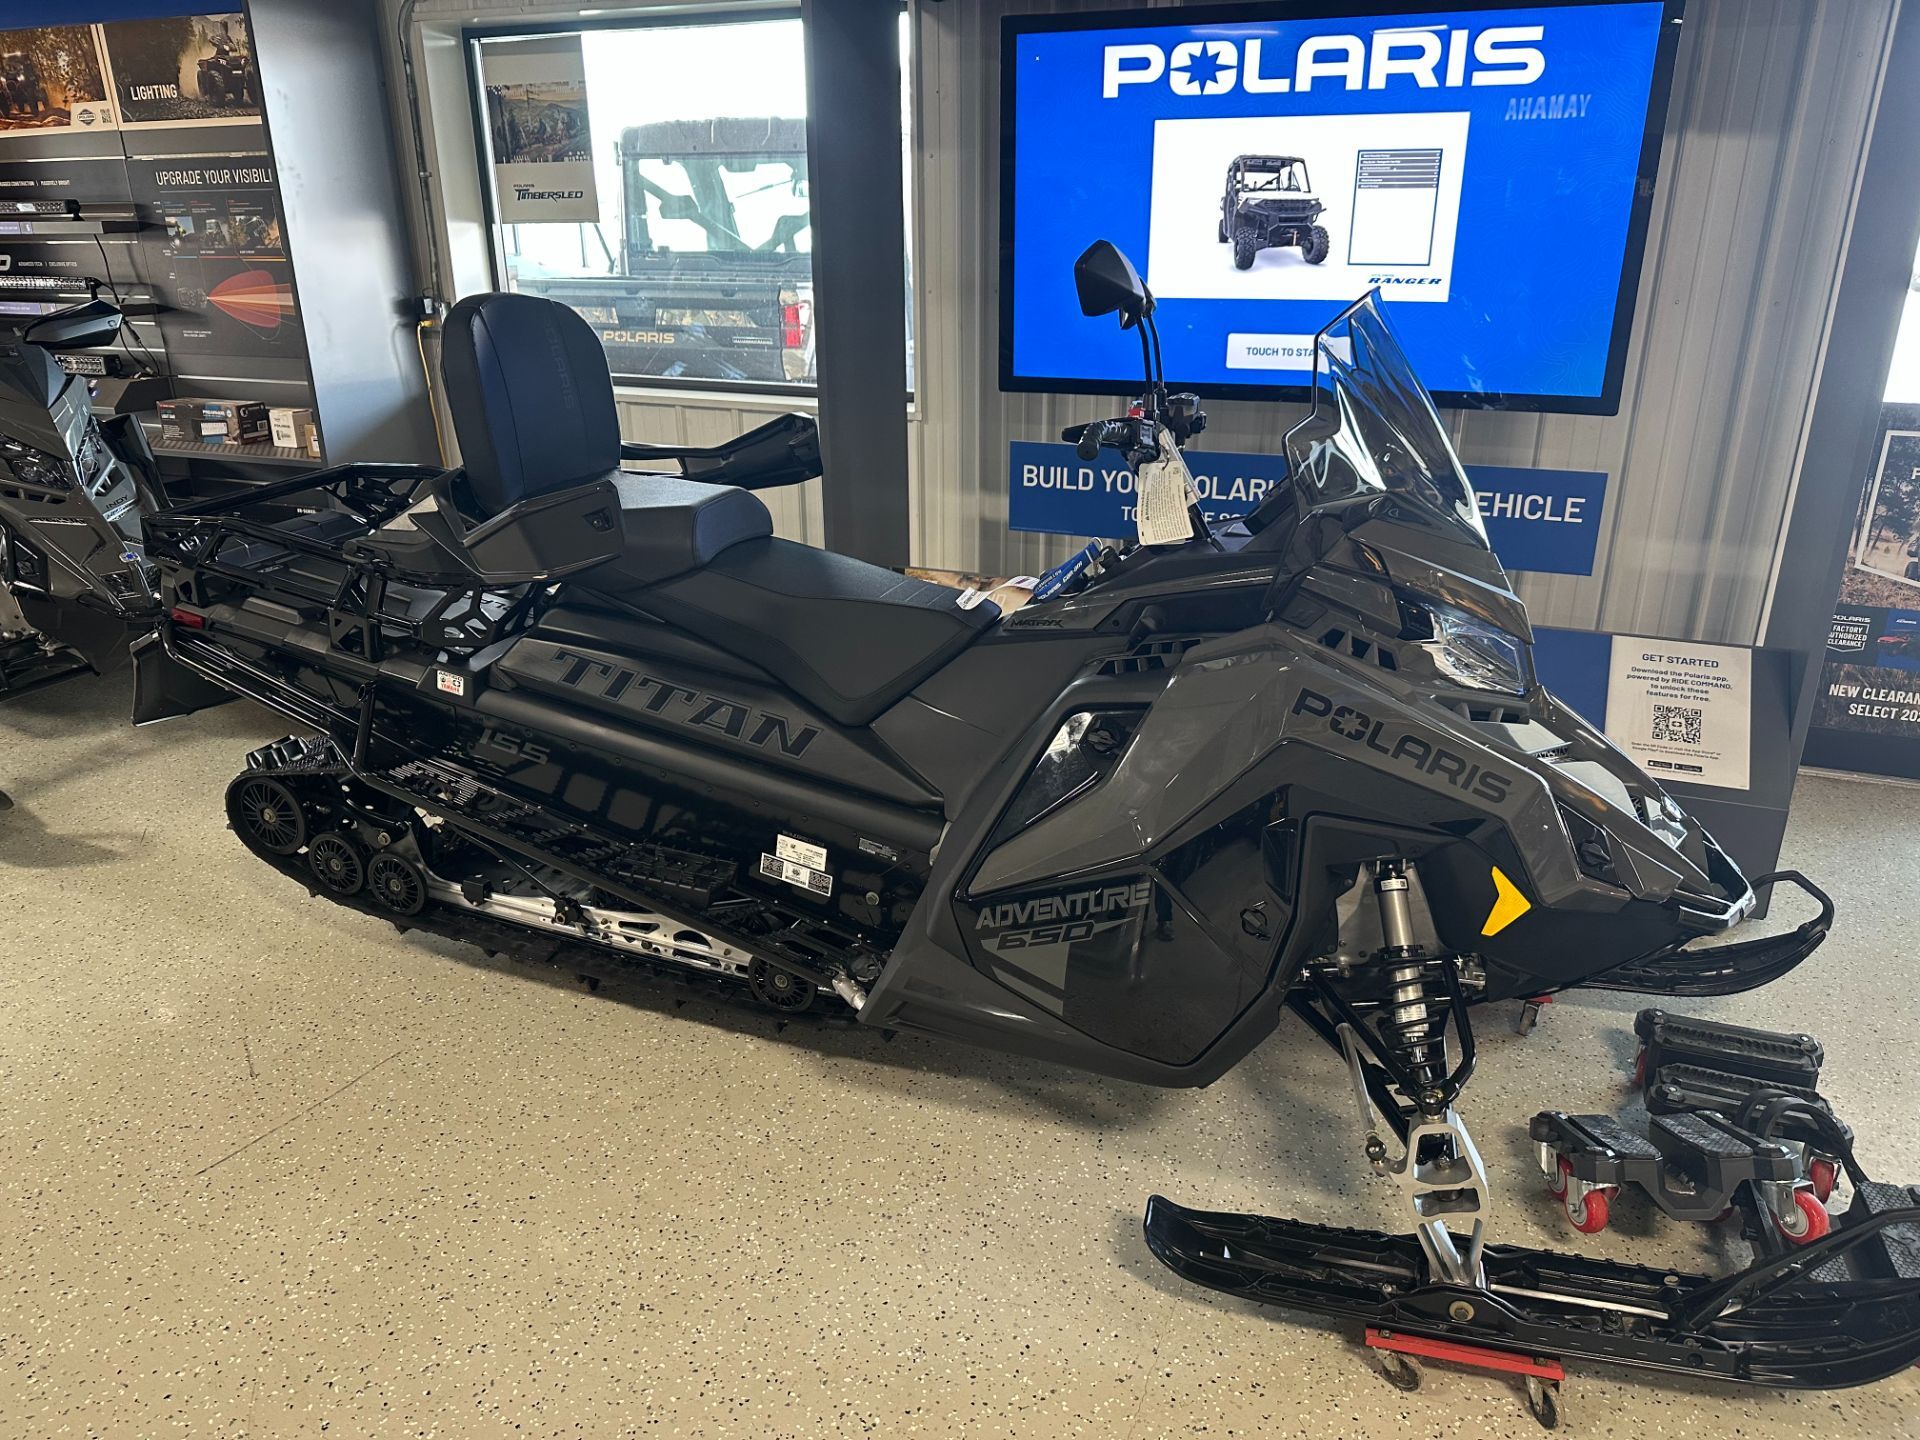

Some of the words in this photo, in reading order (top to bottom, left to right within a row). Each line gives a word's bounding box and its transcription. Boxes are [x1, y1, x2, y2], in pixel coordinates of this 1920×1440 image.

[1103, 25, 1545, 99] POLARIS
[129, 84, 178, 101] LIGHTING
[1505, 94, 1592, 120] AHAMAY
[155, 170, 203, 186] UPGRADE
[202, 169, 232, 184] YOUR
[1368, 277, 1442, 285] RANGER
[603, 331, 675, 344] POLARIS
[1246, 346, 1279, 356] TOUCH
[1281, 347, 1294, 357] TO
[1296, 347, 1316, 357] STA
[1022, 463, 1095, 492] BUILD
[1101, 469, 1139, 494] YO
[1477, 491, 1587, 524] EHICLE
[105, 494, 129, 509] INDY
[1832, 624, 1863, 633] FACTORY
[1827, 638, 1863, 648] CLEARANCE
[1642, 653, 1664, 662] GET
[1666, 656, 1719, 668] STARTED
[1626, 673, 1659, 682] powered
[1661, 676, 1670, 684] by
[1631, 666, 1669, 675] Download
[1684, 672, 1711, 680] Polaris
[1646, 690, 1678, 699] features
[1660, 684, 1686, 692] unlock
[1828, 684, 1860, 698] NEW
[549, 646, 825, 760] TITAN
[1848, 703, 1899, 720] SELECT
[480, 727, 551, 766] 155
[1291, 687, 1512, 804] POLARIS
[975, 882, 1151, 930] ADVENTURE
[996, 920, 1096, 951] 650
